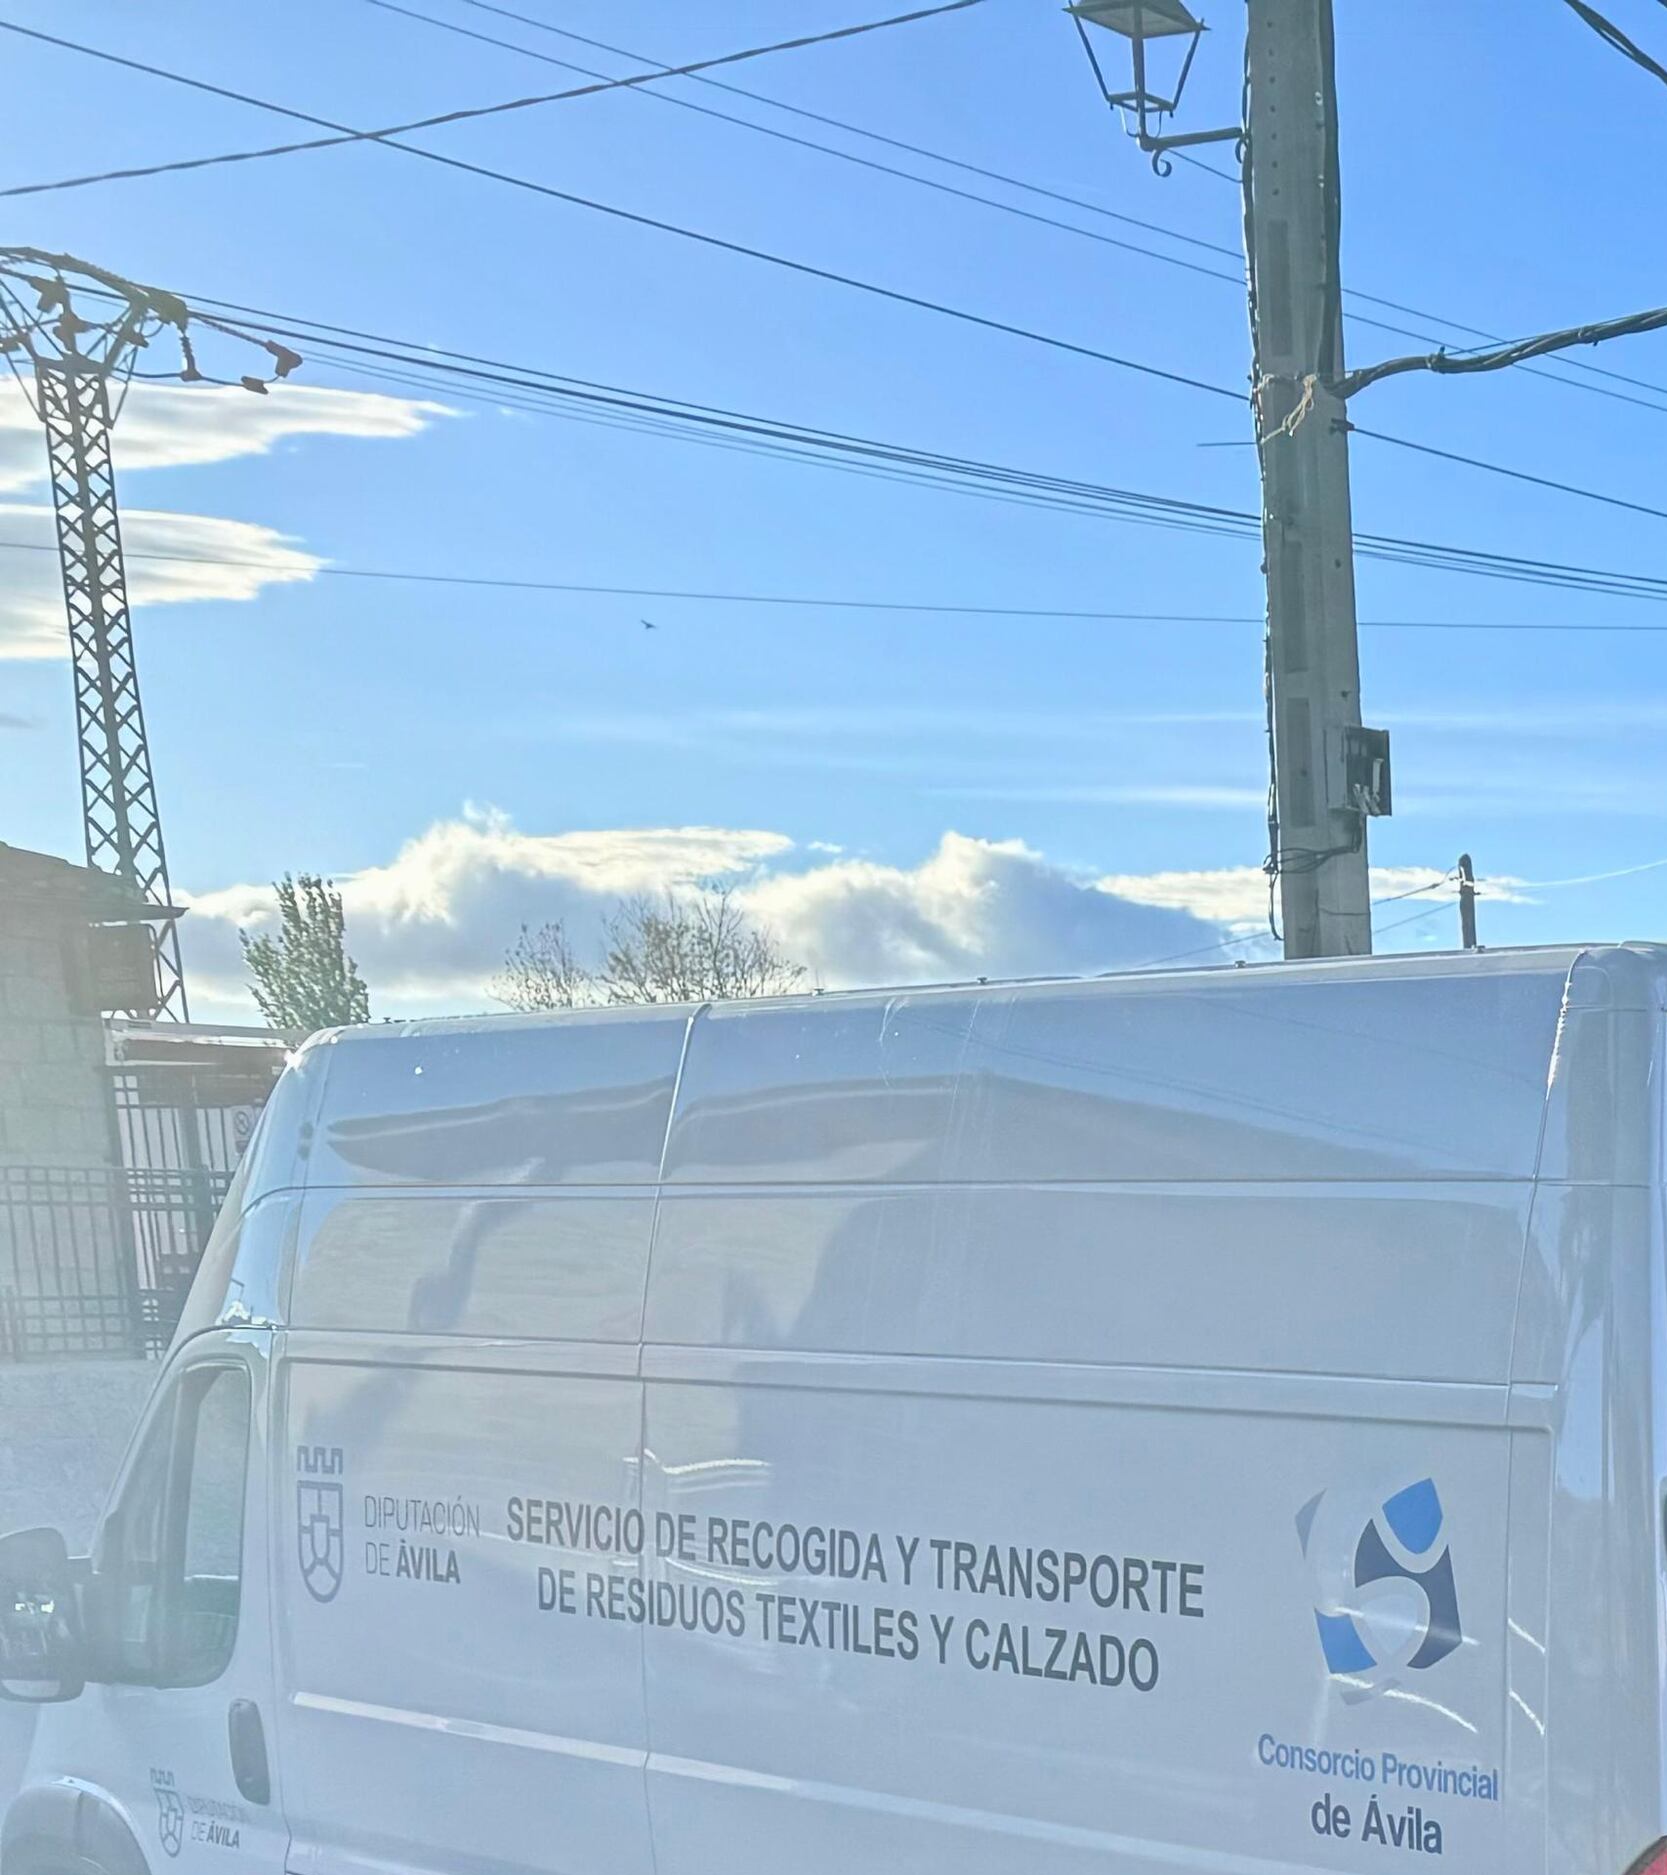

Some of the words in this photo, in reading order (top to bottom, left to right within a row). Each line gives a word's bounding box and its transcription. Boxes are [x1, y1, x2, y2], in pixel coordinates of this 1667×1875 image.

[364, 1495, 481, 1538] DIPUTACIÓN
[364, 1542, 391, 1577] DE
[395, 1538, 462, 1585] ÁVILA
[506, 1496, 645, 1555] SERVICIO
[655, 1511, 697, 1561] DE
[708, 1517, 888, 1583] RECOGIDA
[895, 1535, 920, 1586] Y
[930, 1538, 1205, 1618] TRANSPORTE
[537, 1566, 577, 1615] DE
[586, 1572, 746, 1638] RESIDUOS
[755, 1592, 920, 1661] TEXTILES
[930, 1613, 955, 1664] Y
[965, 1617, 1160, 1692] CALZADO
[1257, 1733, 1376, 1782] Consorcio
[1382, 1752, 1499, 1802] Provincial
[1311, 1793, 1351, 1839] de
[1361, 1794, 1443, 1855] Ávila
